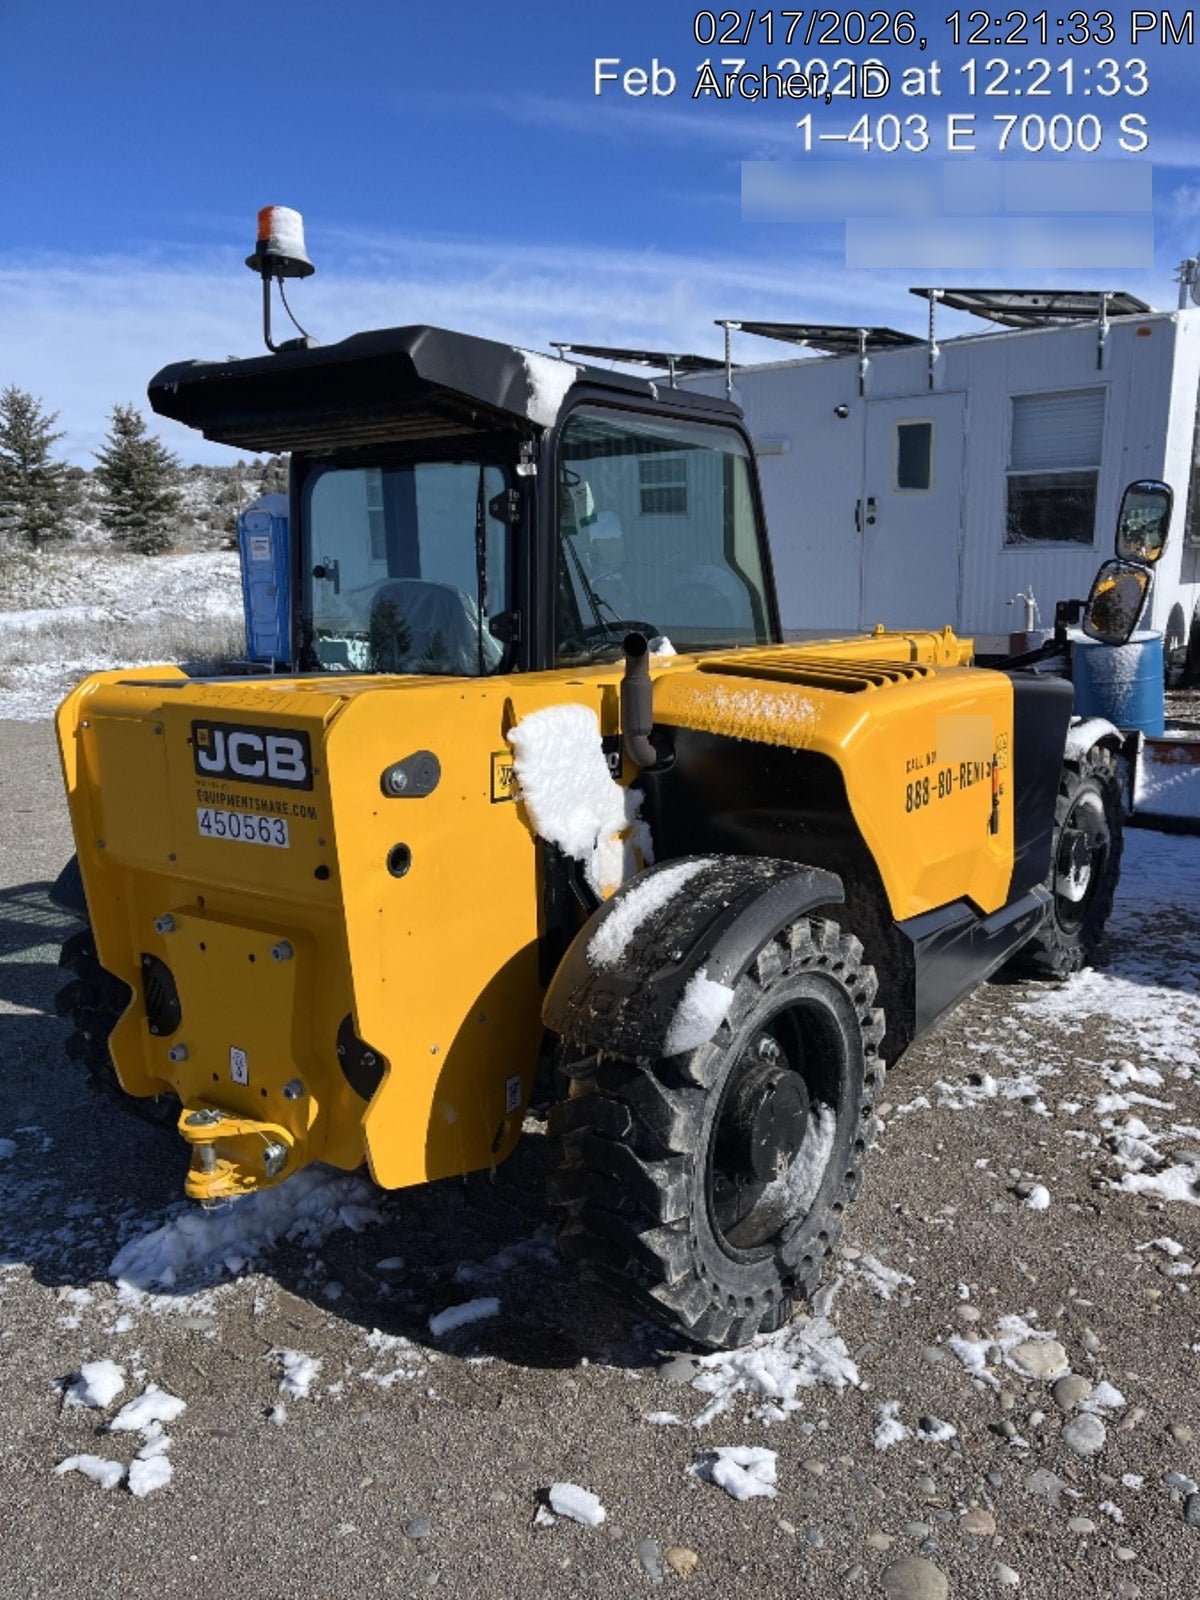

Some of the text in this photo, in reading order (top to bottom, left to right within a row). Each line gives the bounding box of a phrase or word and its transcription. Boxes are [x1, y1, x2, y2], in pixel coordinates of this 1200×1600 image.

[198, 730, 307, 781] JCB
[197, 789, 317, 820] EQUIPMENTSHARE.COM
[201, 810, 286, 845] 450563
